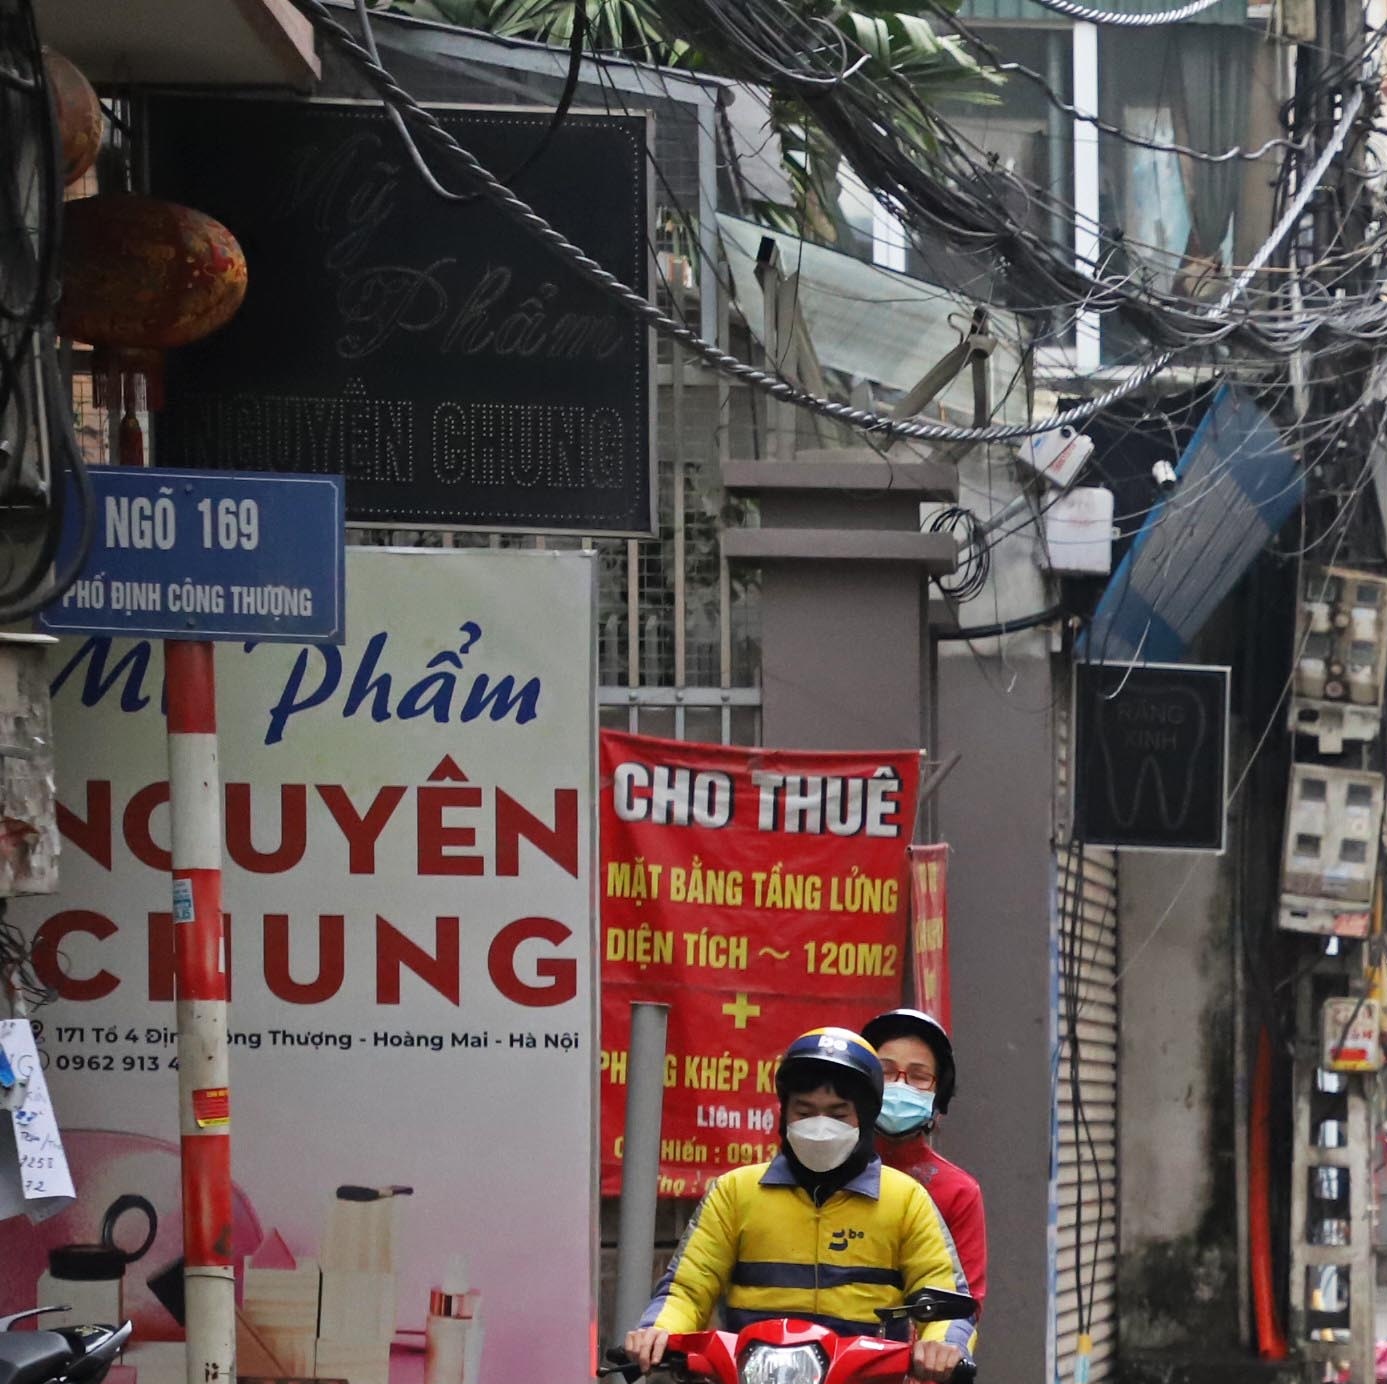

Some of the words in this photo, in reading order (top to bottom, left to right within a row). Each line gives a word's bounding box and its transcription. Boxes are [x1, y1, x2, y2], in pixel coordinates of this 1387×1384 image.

[433, 400, 624, 488] CHUNG
[105, 486, 176, 550] NGÕ
[198, 498, 259, 550] 169
[111, 581, 161, 616] ĐỊNH
[168, 577, 224, 614] CÔNG
[231, 585, 313, 621] THƯỢNG
[614, 761, 732, 829] CHO
[752, 766, 902, 838] THUÊ
[607, 856, 661, 907] MẶT
[670, 855, 743, 907] BẰNG
[752, 860, 820, 911] TẦNG
[830, 866, 898, 914] LỬNG
[606, 922, 673, 969] DIỆN
[683, 929, 748, 971] TÍCH
[804, 942, 897, 977] 120M2
[56, 1027, 84, 1043] 171
[125, 1028, 139, 1044] 4
[268, 1028, 351, 1053] Thượng
[373, 1030, 444, 1054] Hoàng
[451, 1033, 488, 1049] Mai
[509, 1031, 536, 1050] Hà
[544, 1032, 580, 1055] Nội
[57, 1055, 114, 1072] 0962
[122, 1055, 160, 1072] 913
[600, 1051, 677, 1088] PHG
[685, 1051, 749, 1092] KHÉP
[697, 1105, 741, 1130] Liên
[748, 1108, 774, 1135] Hệ
[661, 1135, 708, 1163] Hiến
[848, 1228, 865, 1240] be
